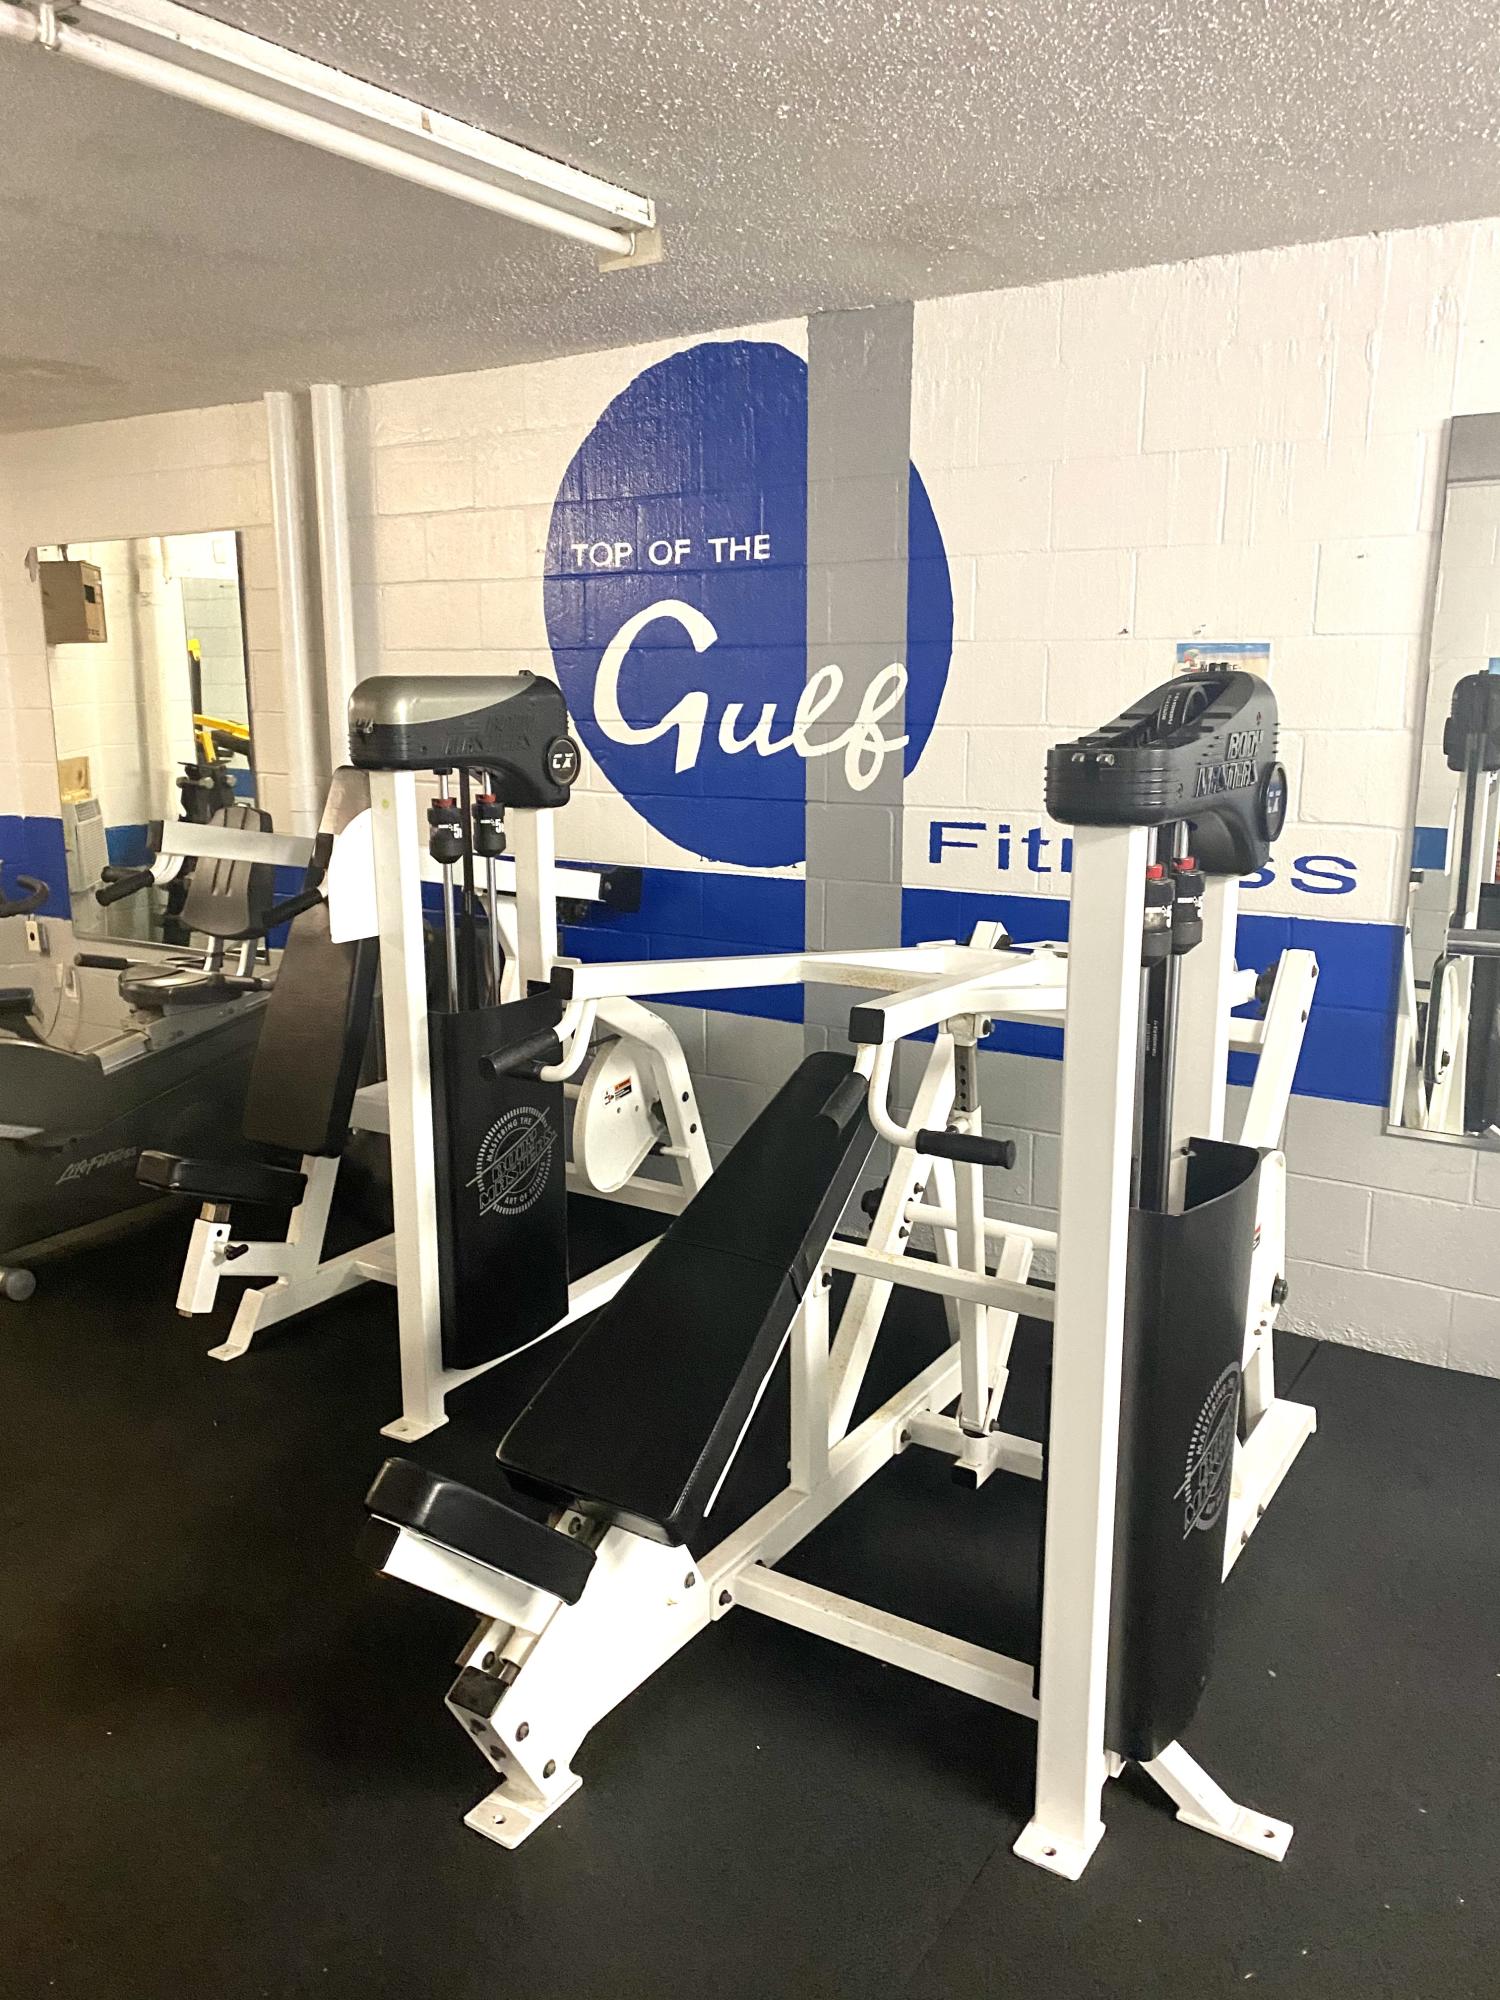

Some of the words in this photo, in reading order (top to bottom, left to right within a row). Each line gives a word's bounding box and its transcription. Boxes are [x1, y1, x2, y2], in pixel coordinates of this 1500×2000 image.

[571, 541, 633, 567] TOP
[649, 539, 690, 565] OF
[708, 534, 770, 563] THE
[593, 599, 909, 791] Gulf
